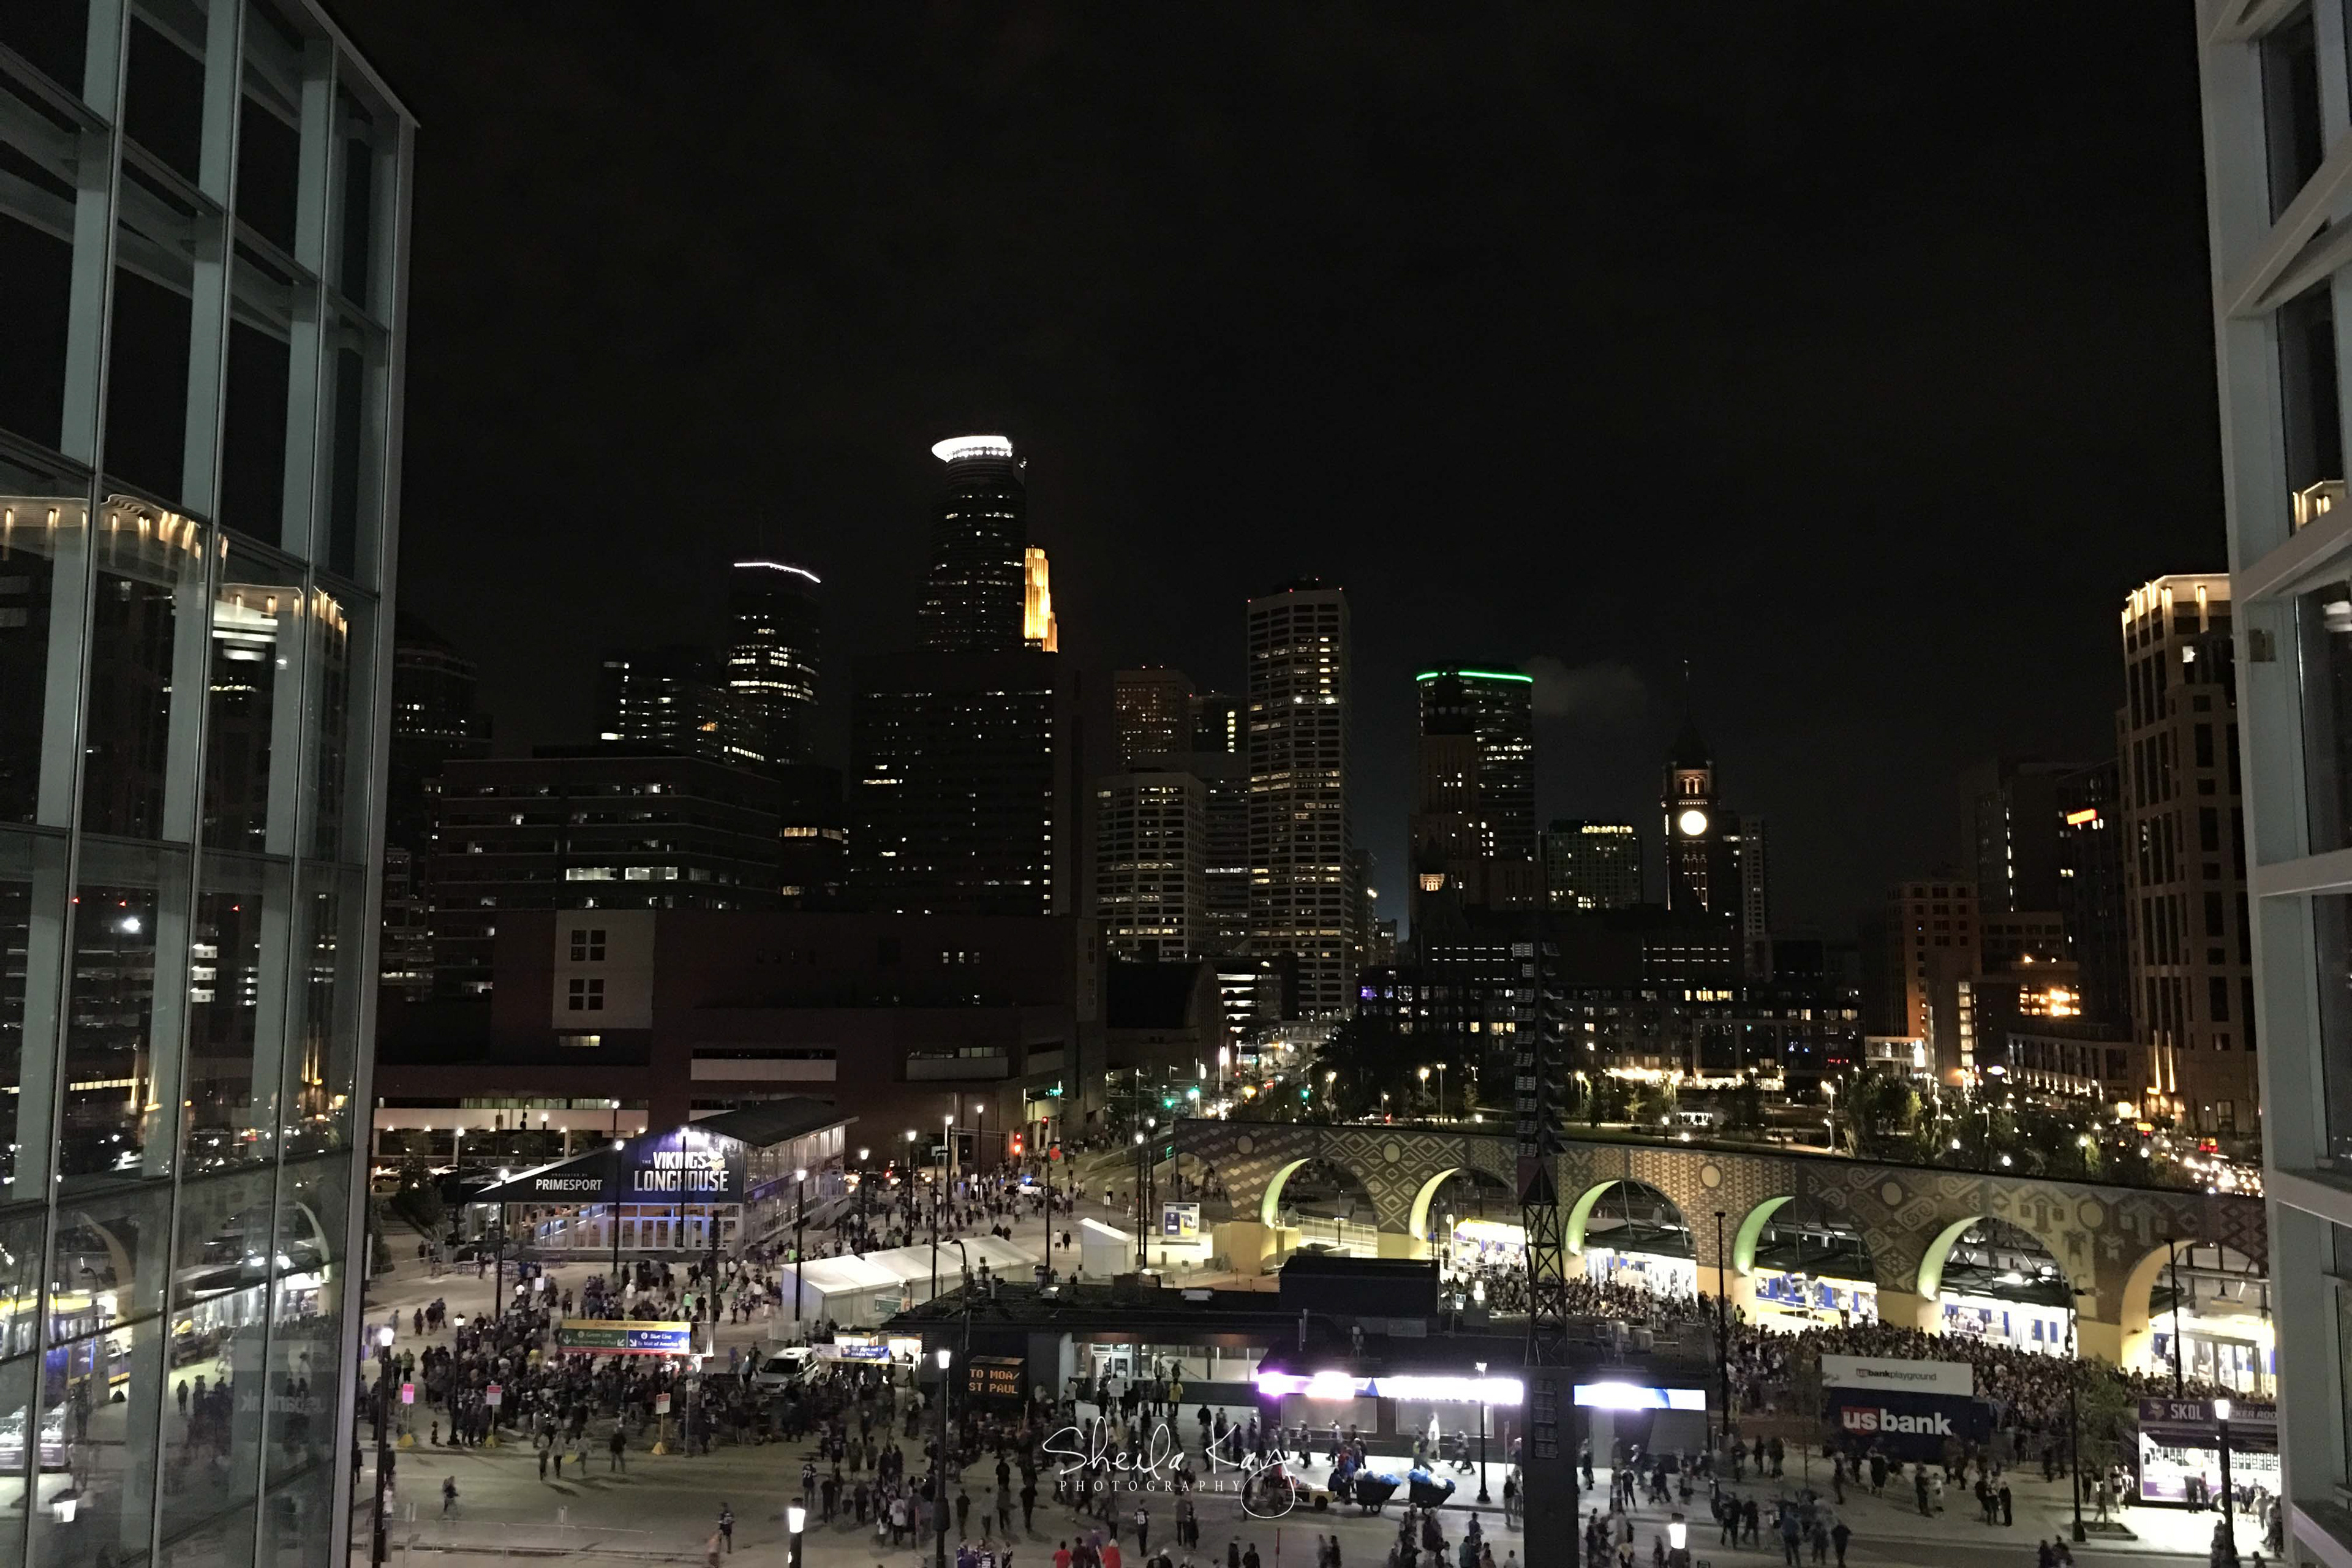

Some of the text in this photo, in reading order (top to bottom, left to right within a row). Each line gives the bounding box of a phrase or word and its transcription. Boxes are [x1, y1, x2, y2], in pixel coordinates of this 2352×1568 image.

[653, 1152, 706, 1169] VIKINGS
[535, 1178, 603, 1191] PRIMESPORT
[634, 1170, 729, 1191] LONGHOUSE
[969, 1368, 984, 1378] TO
[968, 1382, 1018, 1394] ST PAUL
[2170, 1403, 2204, 1420] SKOL
[803, 1469, 812, 1478] 77
